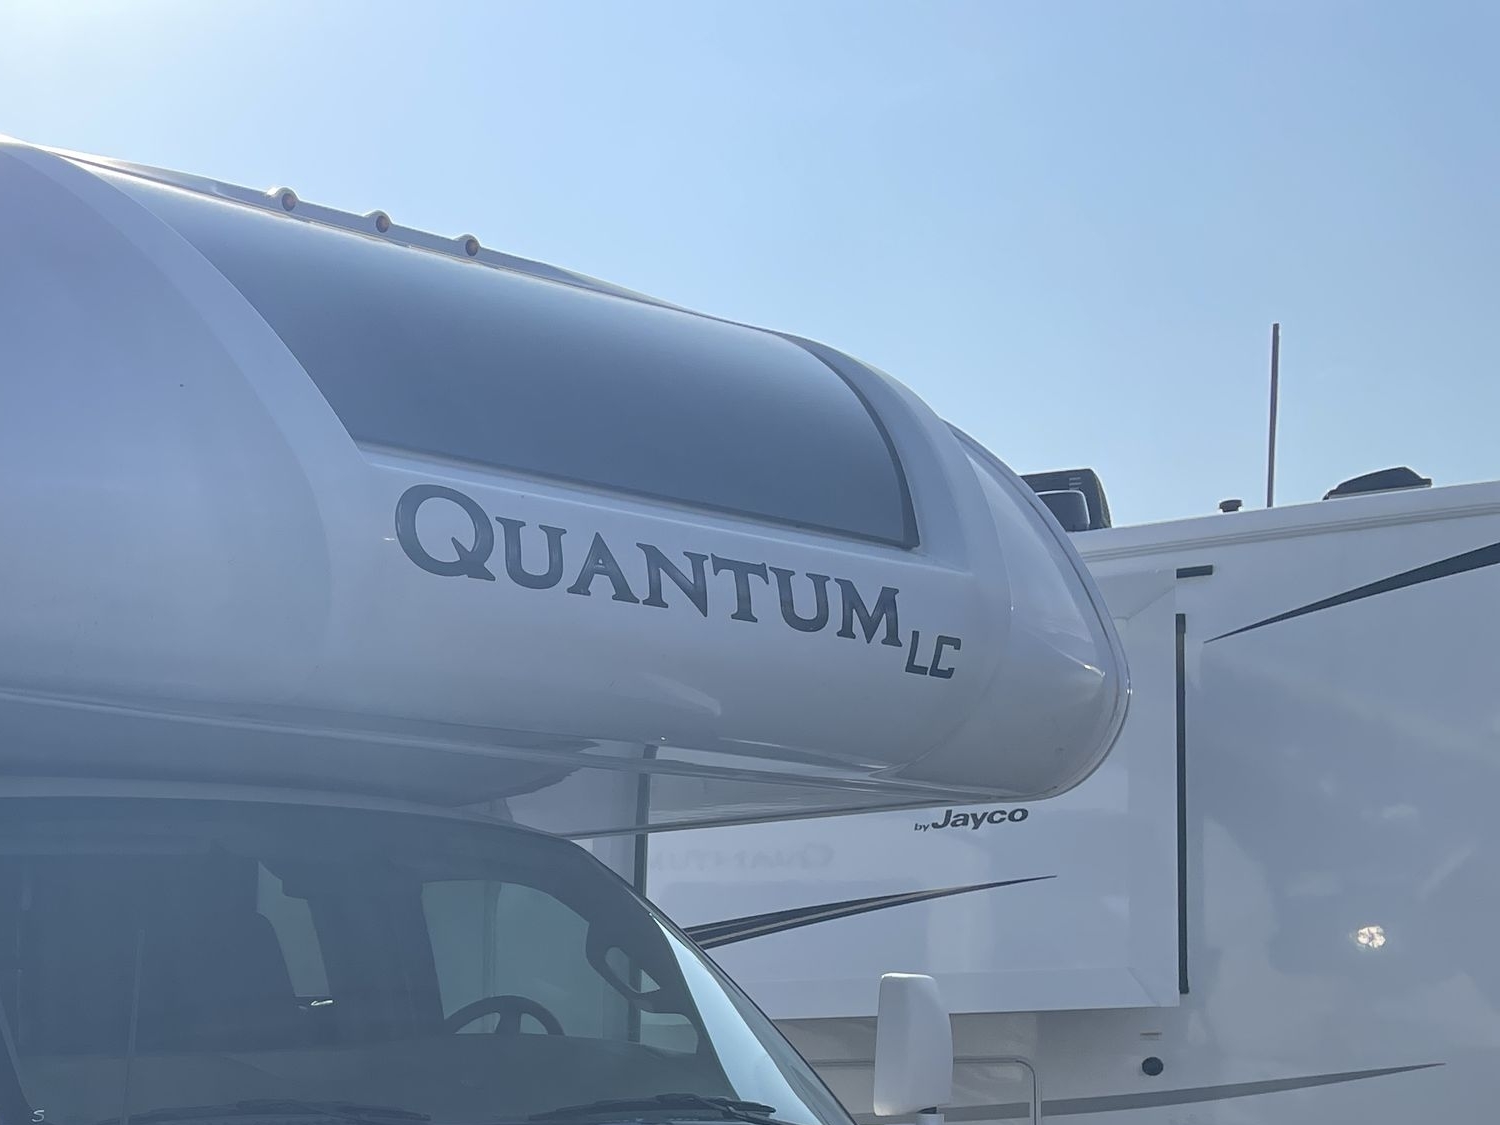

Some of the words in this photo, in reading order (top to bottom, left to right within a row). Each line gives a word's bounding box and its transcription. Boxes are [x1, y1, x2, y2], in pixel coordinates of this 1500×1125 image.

[394, 483, 903, 648] QUANTUM
[904, 630, 962, 680] LC
[914, 823, 930, 832] by
[932, 808, 1029, 830] Jayco
